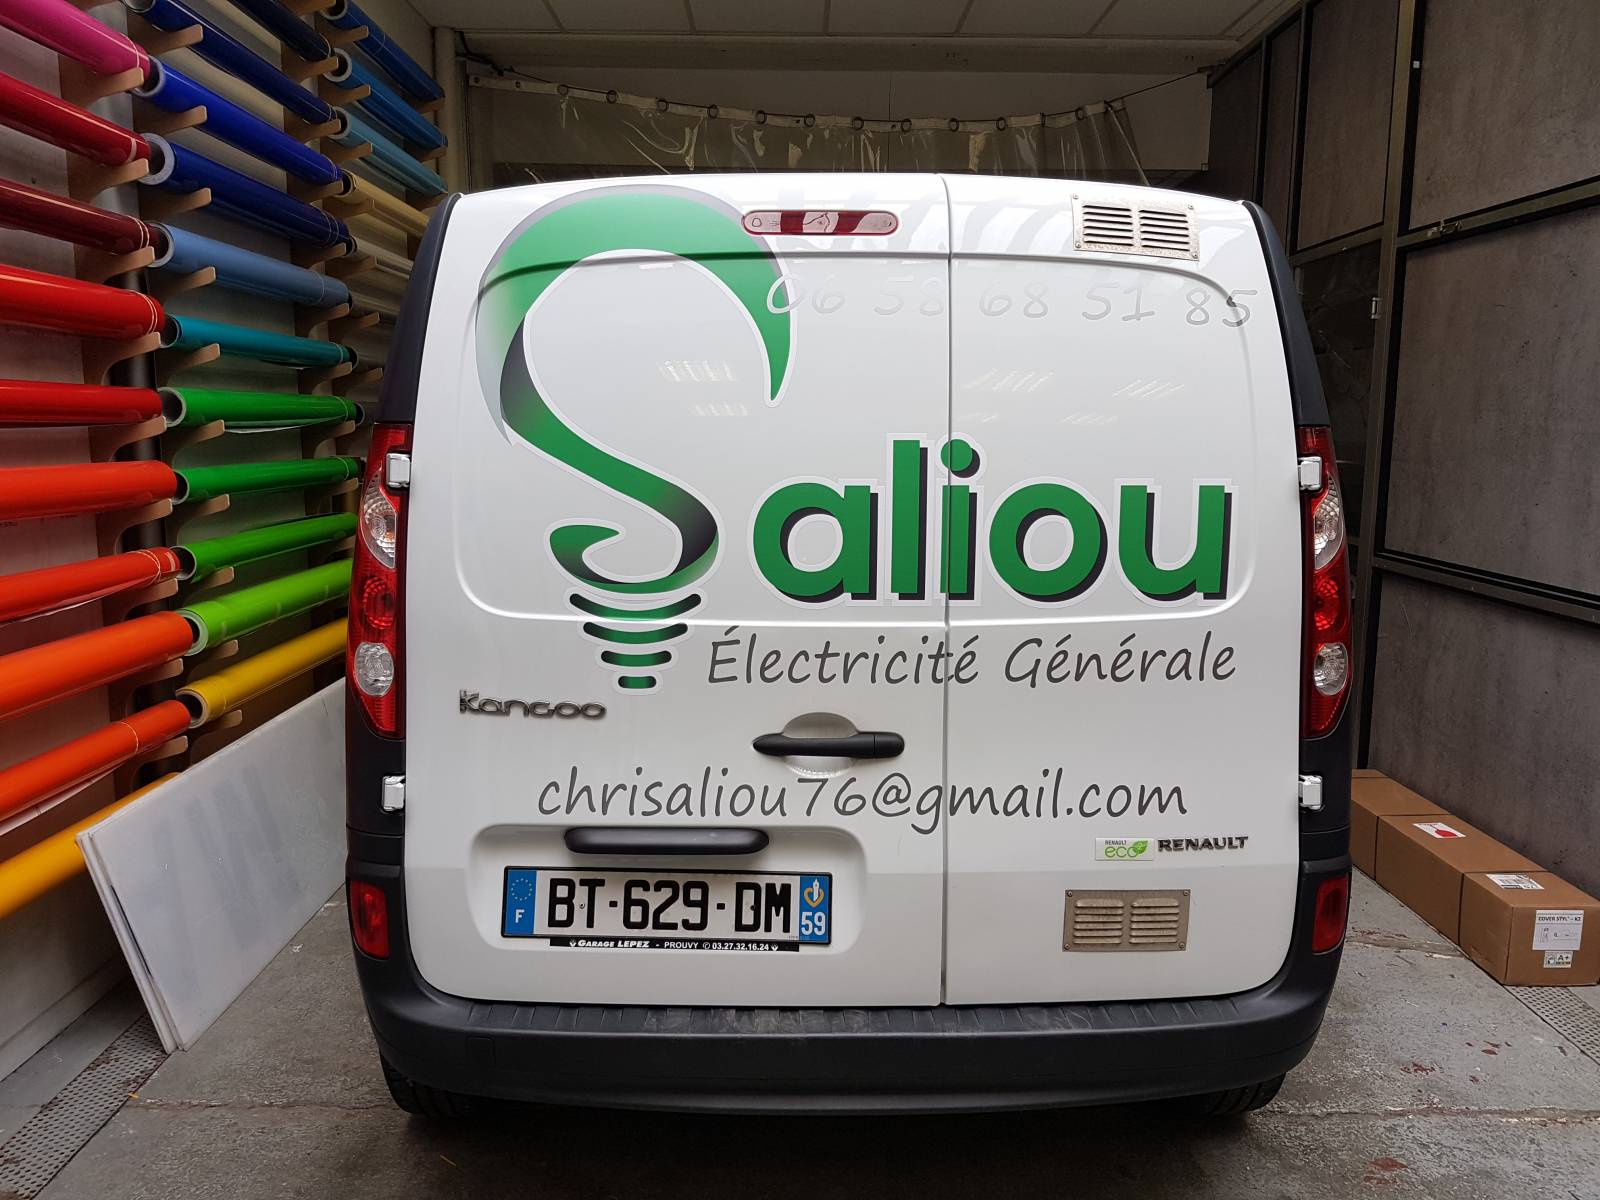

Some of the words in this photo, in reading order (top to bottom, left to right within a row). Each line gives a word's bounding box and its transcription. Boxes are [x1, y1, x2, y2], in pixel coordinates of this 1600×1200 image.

[873, 275, 945, 317] 58
[978, 282, 1049, 319] 68
[1081, 282, 1156, 322] 51
[1185, 287, 1259, 328] 85
[707, 626, 980, 685] Électricité
[1004, 630, 1237, 689] Générale
[459, 690, 607, 720] Kangoo
[538, 766, 1188, 835] chrisaliou76@gmail.com
[1157, 836, 1249, 852] RENAULT
[514, 908, 526, 924] F
[547, 877, 792, 934] BT-629-DM
[801, 911, 826, 936] 59
[577, 939, 616, 948] GARAGE
[617, 940, 651, 949] LEPEZ
[664, 941, 699, 949] PROUVY
[712, 941, 770, 951] 03.27.32.16.24
